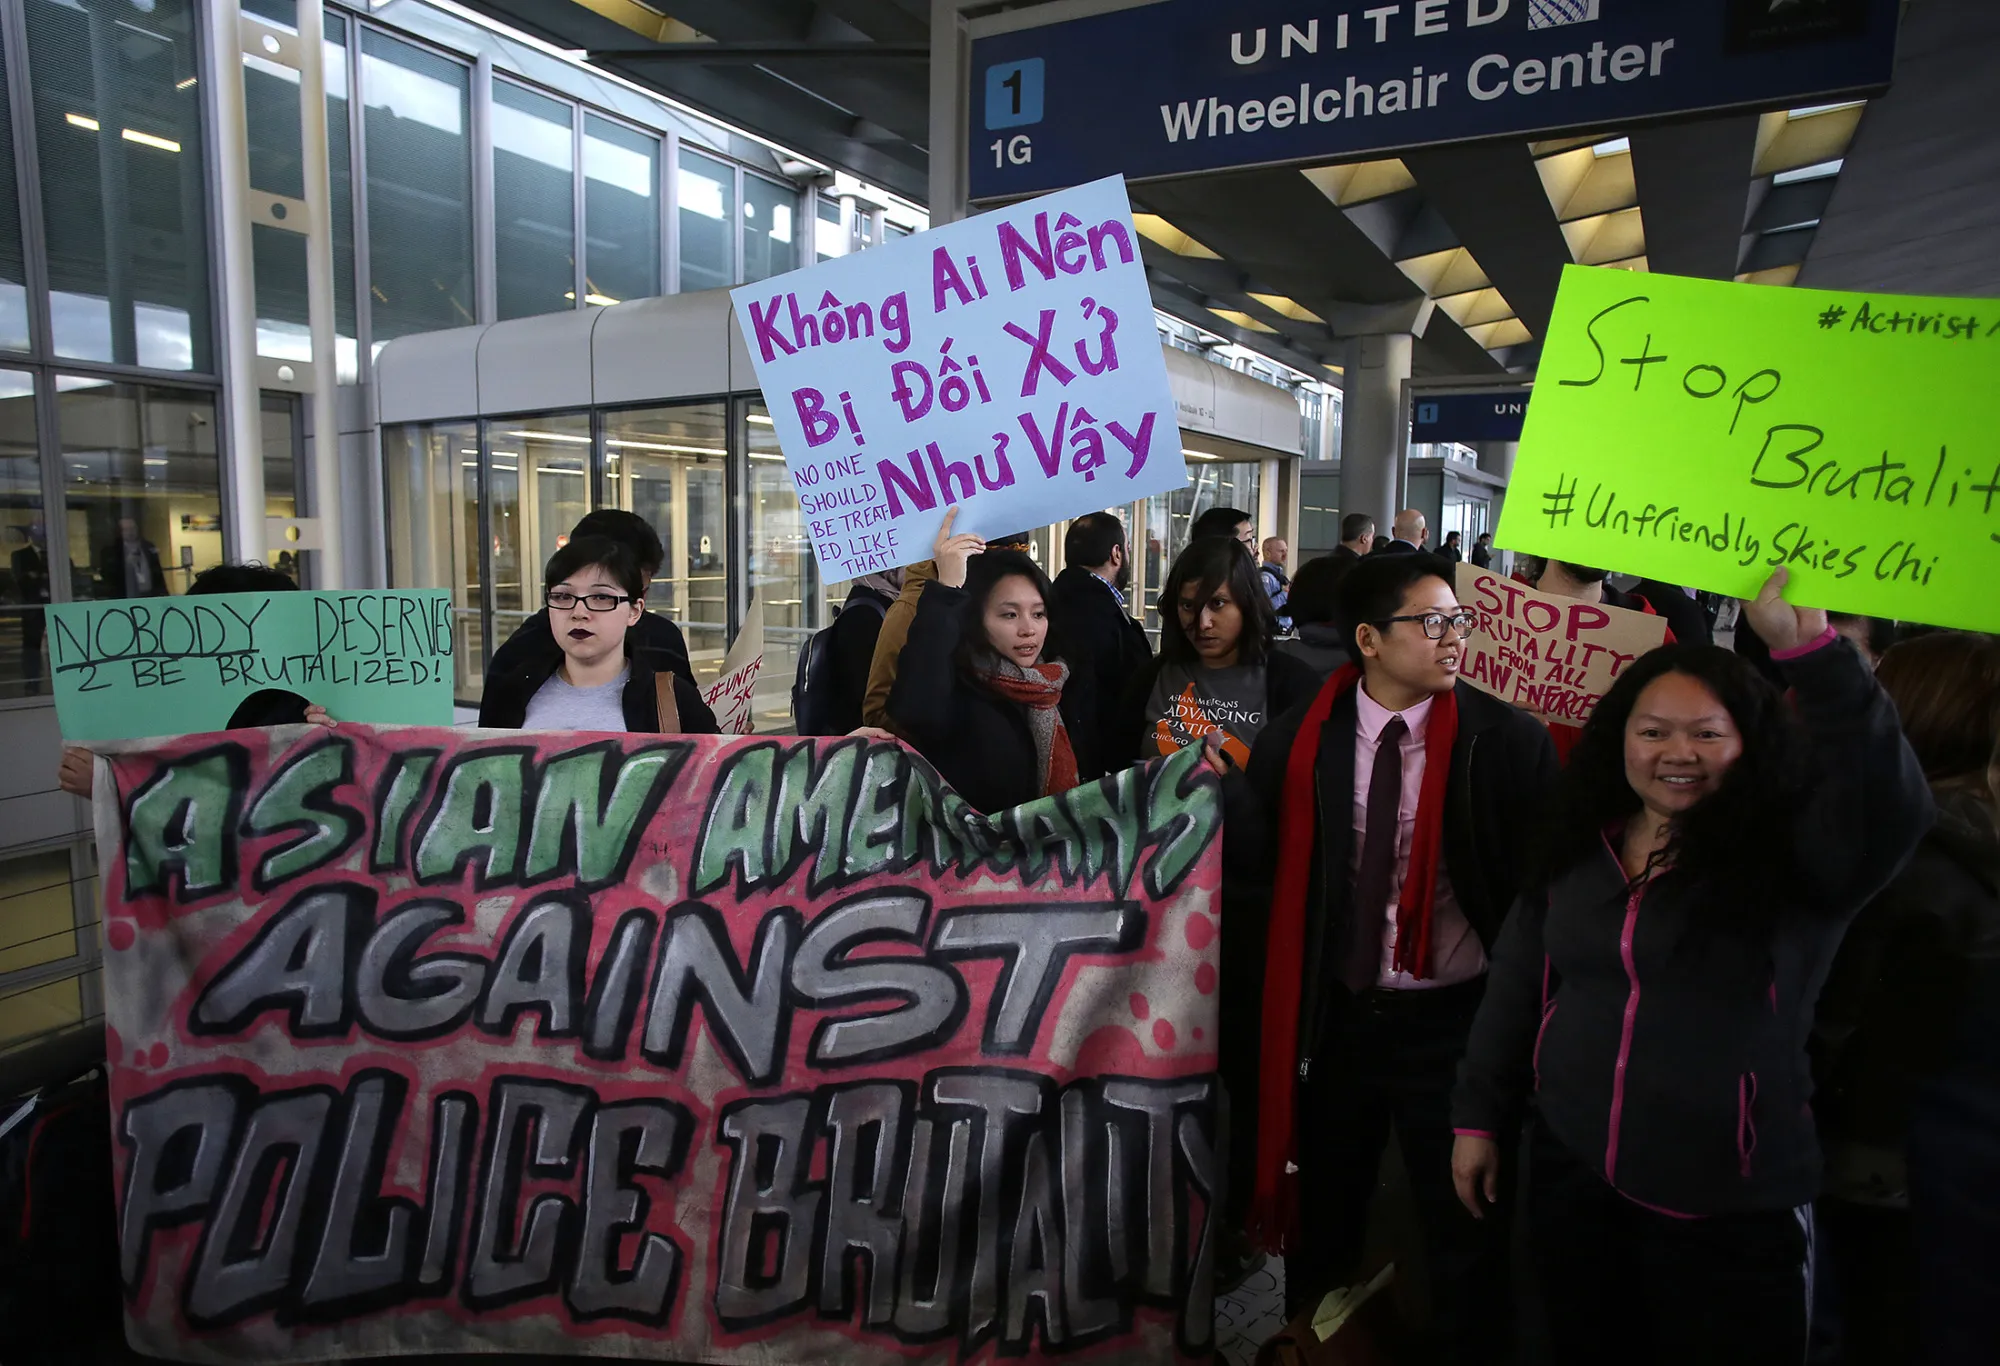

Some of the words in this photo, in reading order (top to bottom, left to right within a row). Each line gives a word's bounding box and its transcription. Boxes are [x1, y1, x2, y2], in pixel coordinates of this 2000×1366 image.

[1230, 0, 1510, 65] UNITED
[1002, 70, 1021, 114] 1
[1160, 67, 1448, 142] Wheelchair
[1467, 38, 1675, 100] Center
[990, 135, 1032, 167] 1G
[748, 289, 911, 363] Không
[932, 245, 989, 313] Ai
[996, 211, 1134, 291] Nên
[1818, 301, 2000, 339] #Activist
[791, 386, 866, 448] Bị
[891, 337, 992, 423] Đối
[1002, 296, 1119, 397] Xử
[1558, 297, 1781, 435] Stop
[1424, 407, 1431, 420] 1
[794, 463, 820, 488] NO
[825, 452, 866, 481] ONE
[877, 432, 1016, 520] Như
[1017, 401, 1157, 483] Vậy
[1750, 424, 2000, 520] Brutalit
[800, 483, 878, 515] SHOULD
[809, 518, 838, 539] BE
[818, 542, 842, 562] ED
[848, 528, 899, 556] LIKE
[840, 548, 897, 575] THAT!
[53, 599, 270, 665] NOBODY
[313, 596, 453, 657] DESERVES
[1474, 575, 1610, 641] STOP
[131, 656, 187, 688] BE
[1459, 647, 1512, 694] LAW
[1498, 645, 1536, 680] FROM
[1544, 664, 1587, 690] ALL
[1164, 704, 1261, 725] ADVANCING
[1151, 731, 1189, 746] CHICAGO
[124, 736, 692, 902] ASIAN
[694, 738, 1223, 902] AMERANS
[190, 881, 1145, 1086] AGAINST
[119, 1066, 698, 1330] POLICE
[712, 1065, 1219, 1355] BRUTALITY
